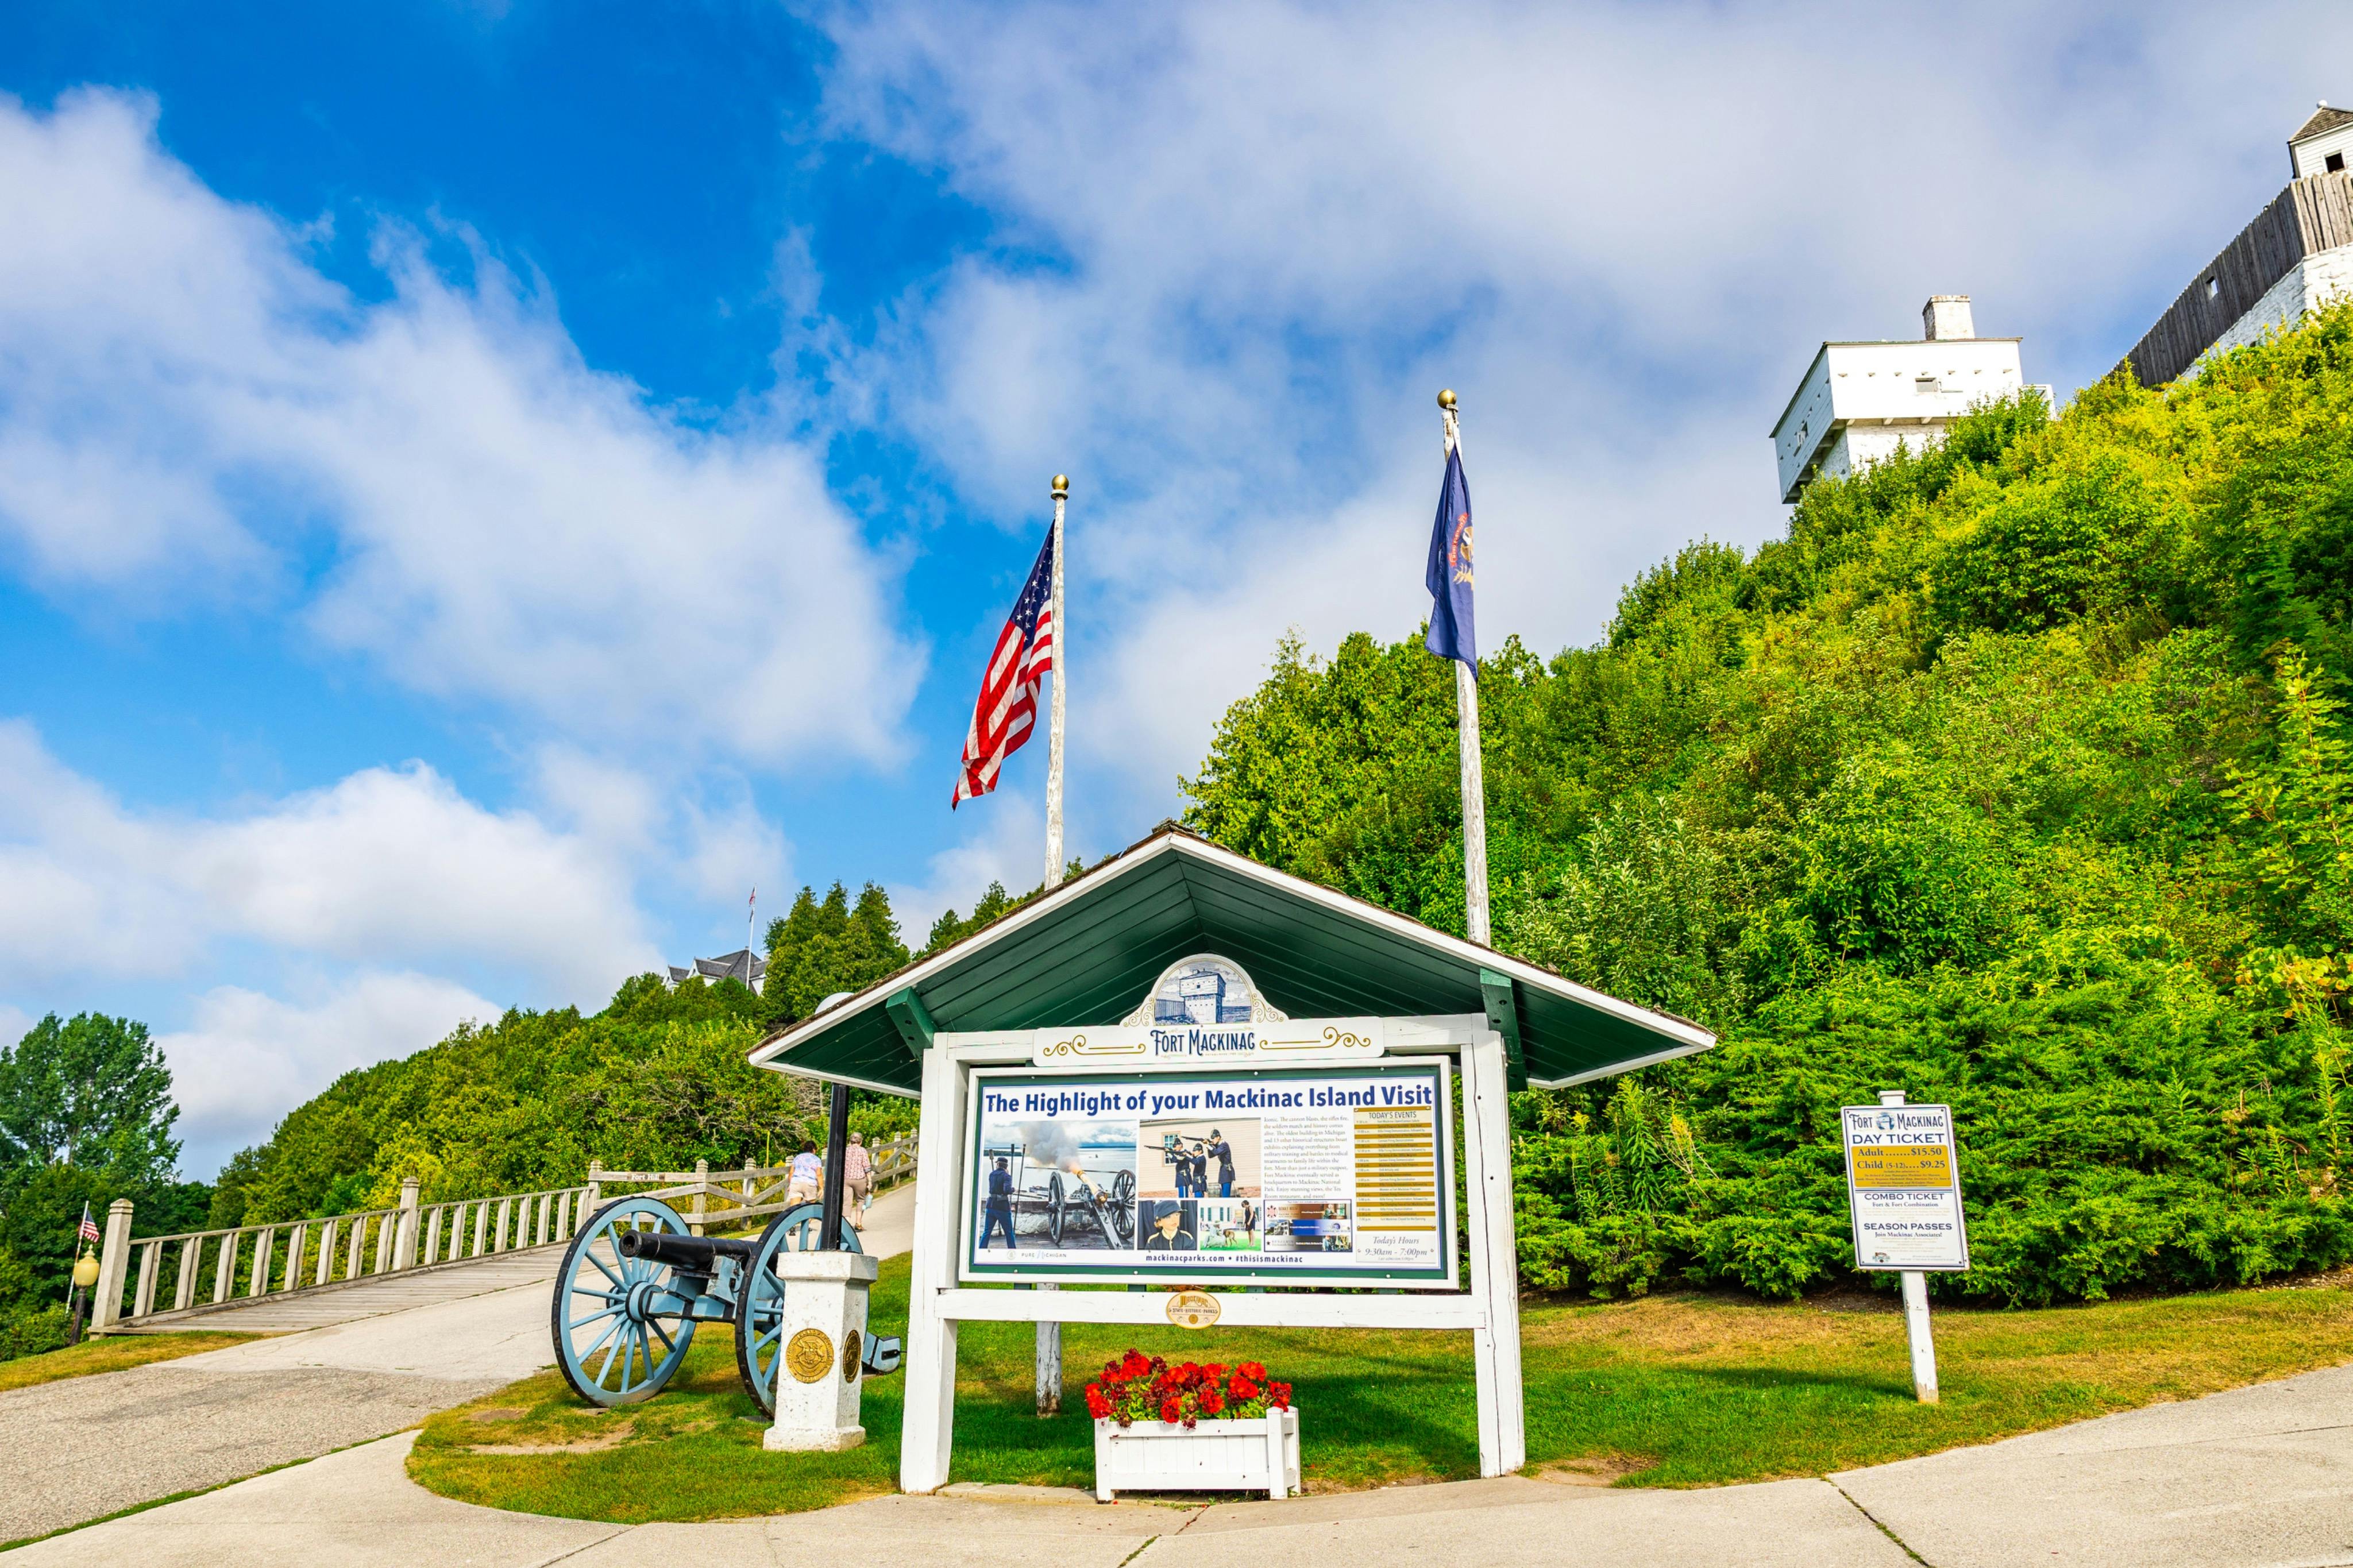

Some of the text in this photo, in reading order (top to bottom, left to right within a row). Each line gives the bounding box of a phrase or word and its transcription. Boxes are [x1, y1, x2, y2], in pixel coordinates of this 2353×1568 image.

[986, 1084, 1432, 1117] The Highlight of your Mackinac Island Visit
[1852, 1133, 1945, 1144] DAY TICKET
[1857, 1161, 1883, 1169] Child
[1373, 1236, 1419, 1246] Today's Hours
[1365, 1248, 1392, 1256] 9:30am
[1400, 1248, 1428, 1258] 7:00pm
[1145, 1254, 1303, 1263] mackinacparks.com #thisismackinac
